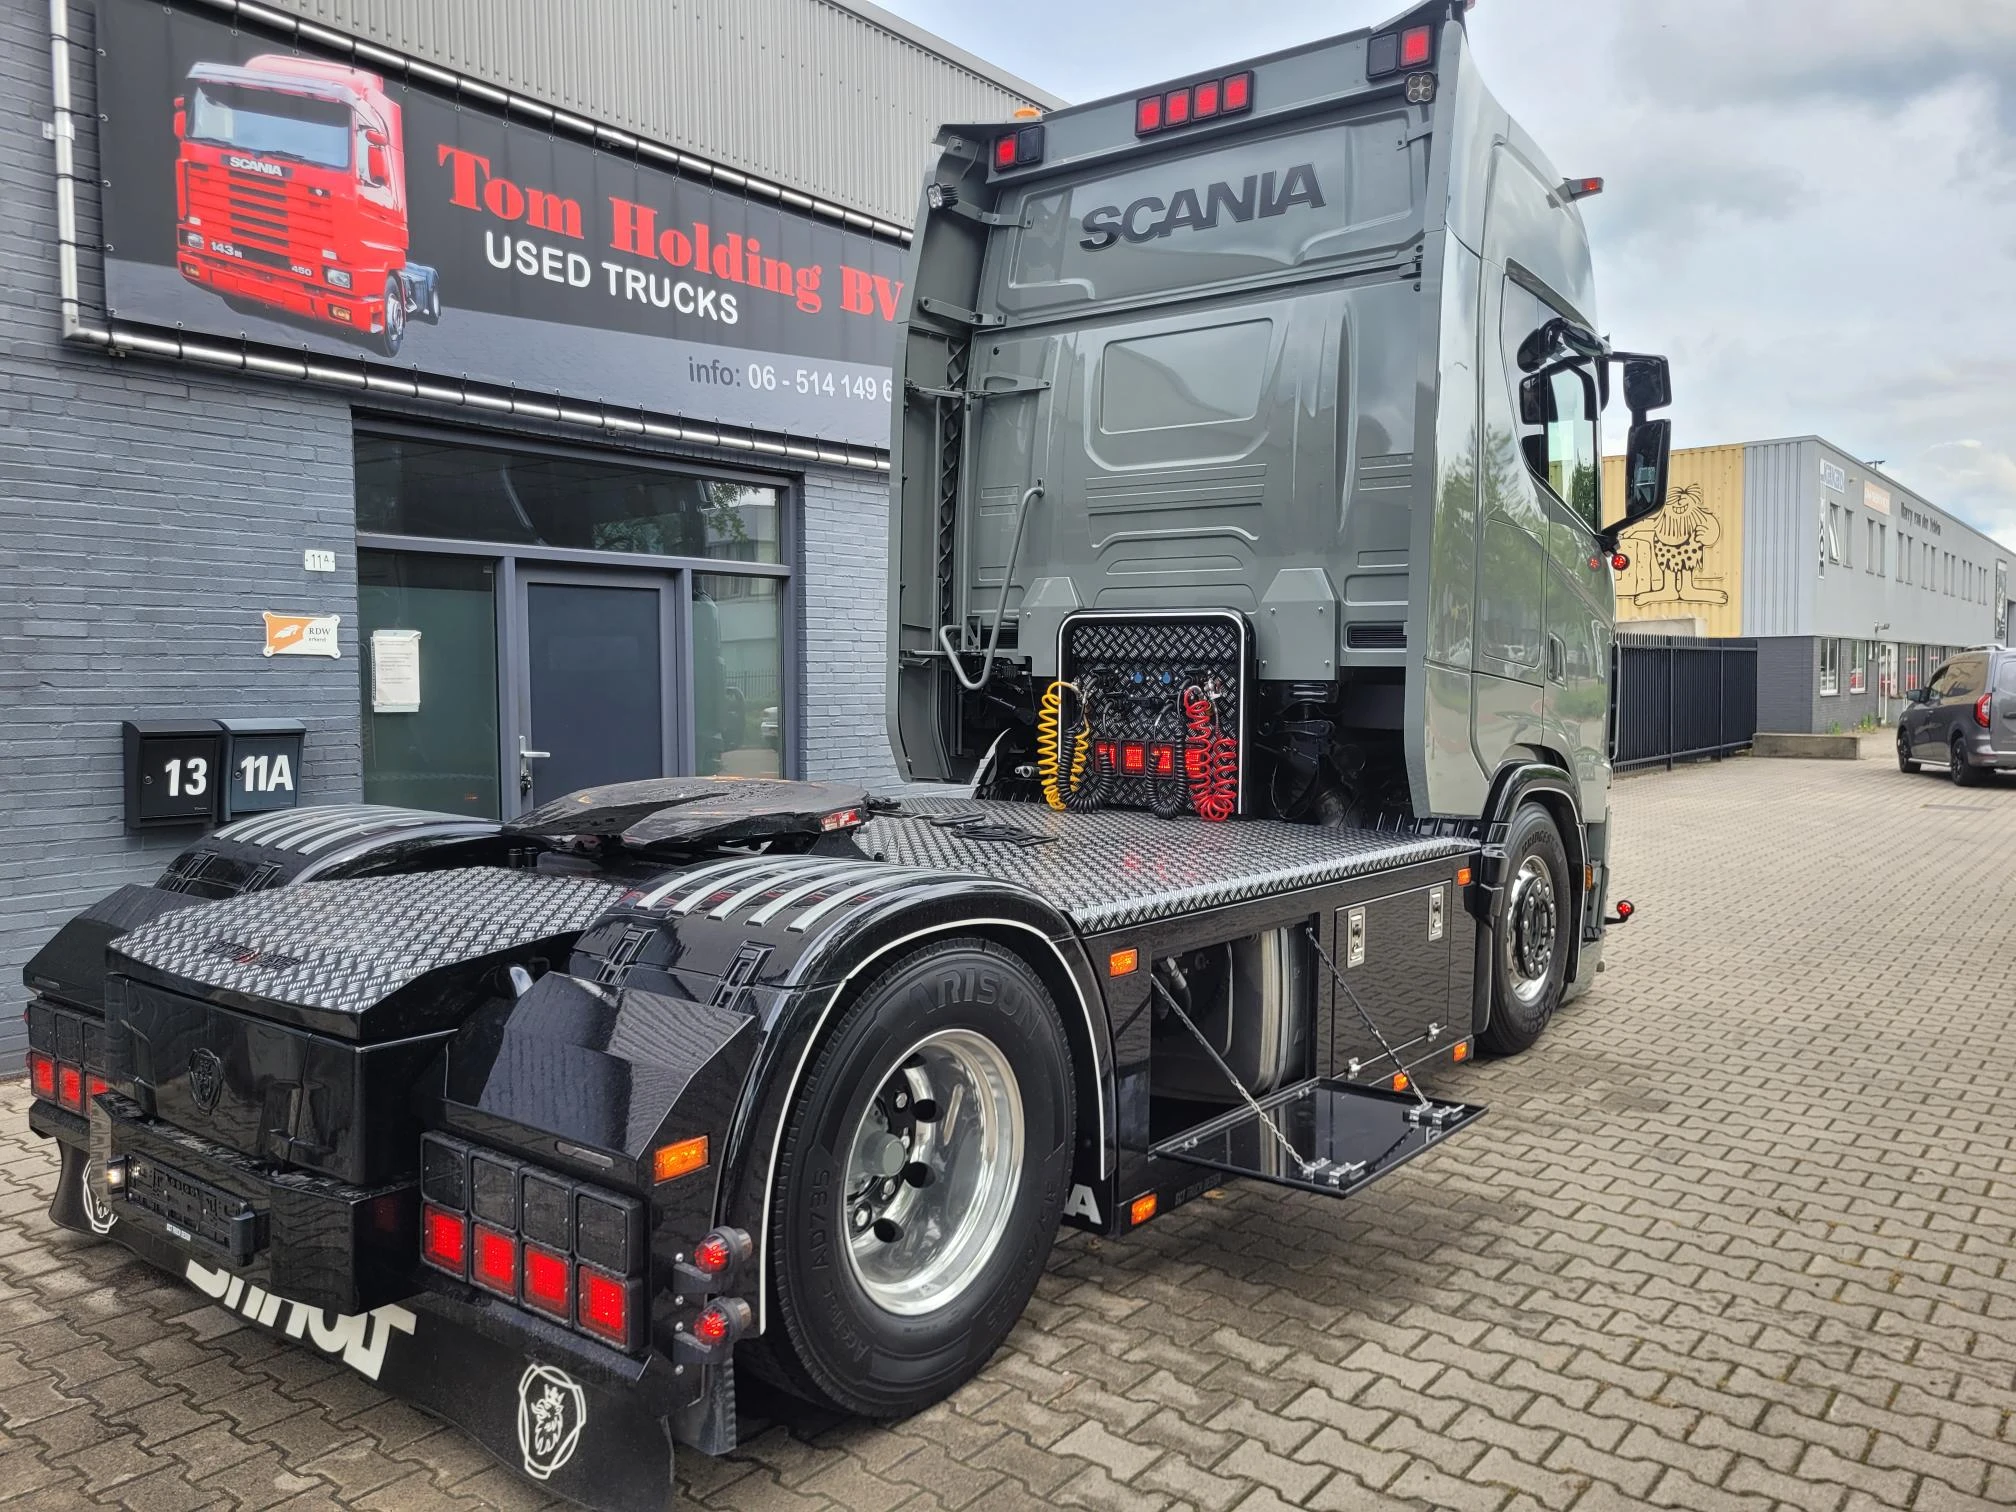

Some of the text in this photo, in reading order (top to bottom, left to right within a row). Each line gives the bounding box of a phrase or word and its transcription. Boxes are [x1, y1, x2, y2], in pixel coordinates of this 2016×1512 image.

[229, 156, 283, 177] SCANIA
[1079, 161, 1327, 253] SCANIA
[437, 143, 904, 322] Tom Holding BV
[291, 265, 313, 277] 450
[485, 229, 738, 325] USED TRUCKS
[688, 356, 741, 387] info:
[748, 363, 777, 391] 06
[795, 369, 836, 397] 514
[840, 373, 877, 401] 149
[311, 553, 330, 569] 11A
[309, 627, 331, 636] RDW
[165, 757, 208, 797] 13
[240, 754, 294, 792] 11A
